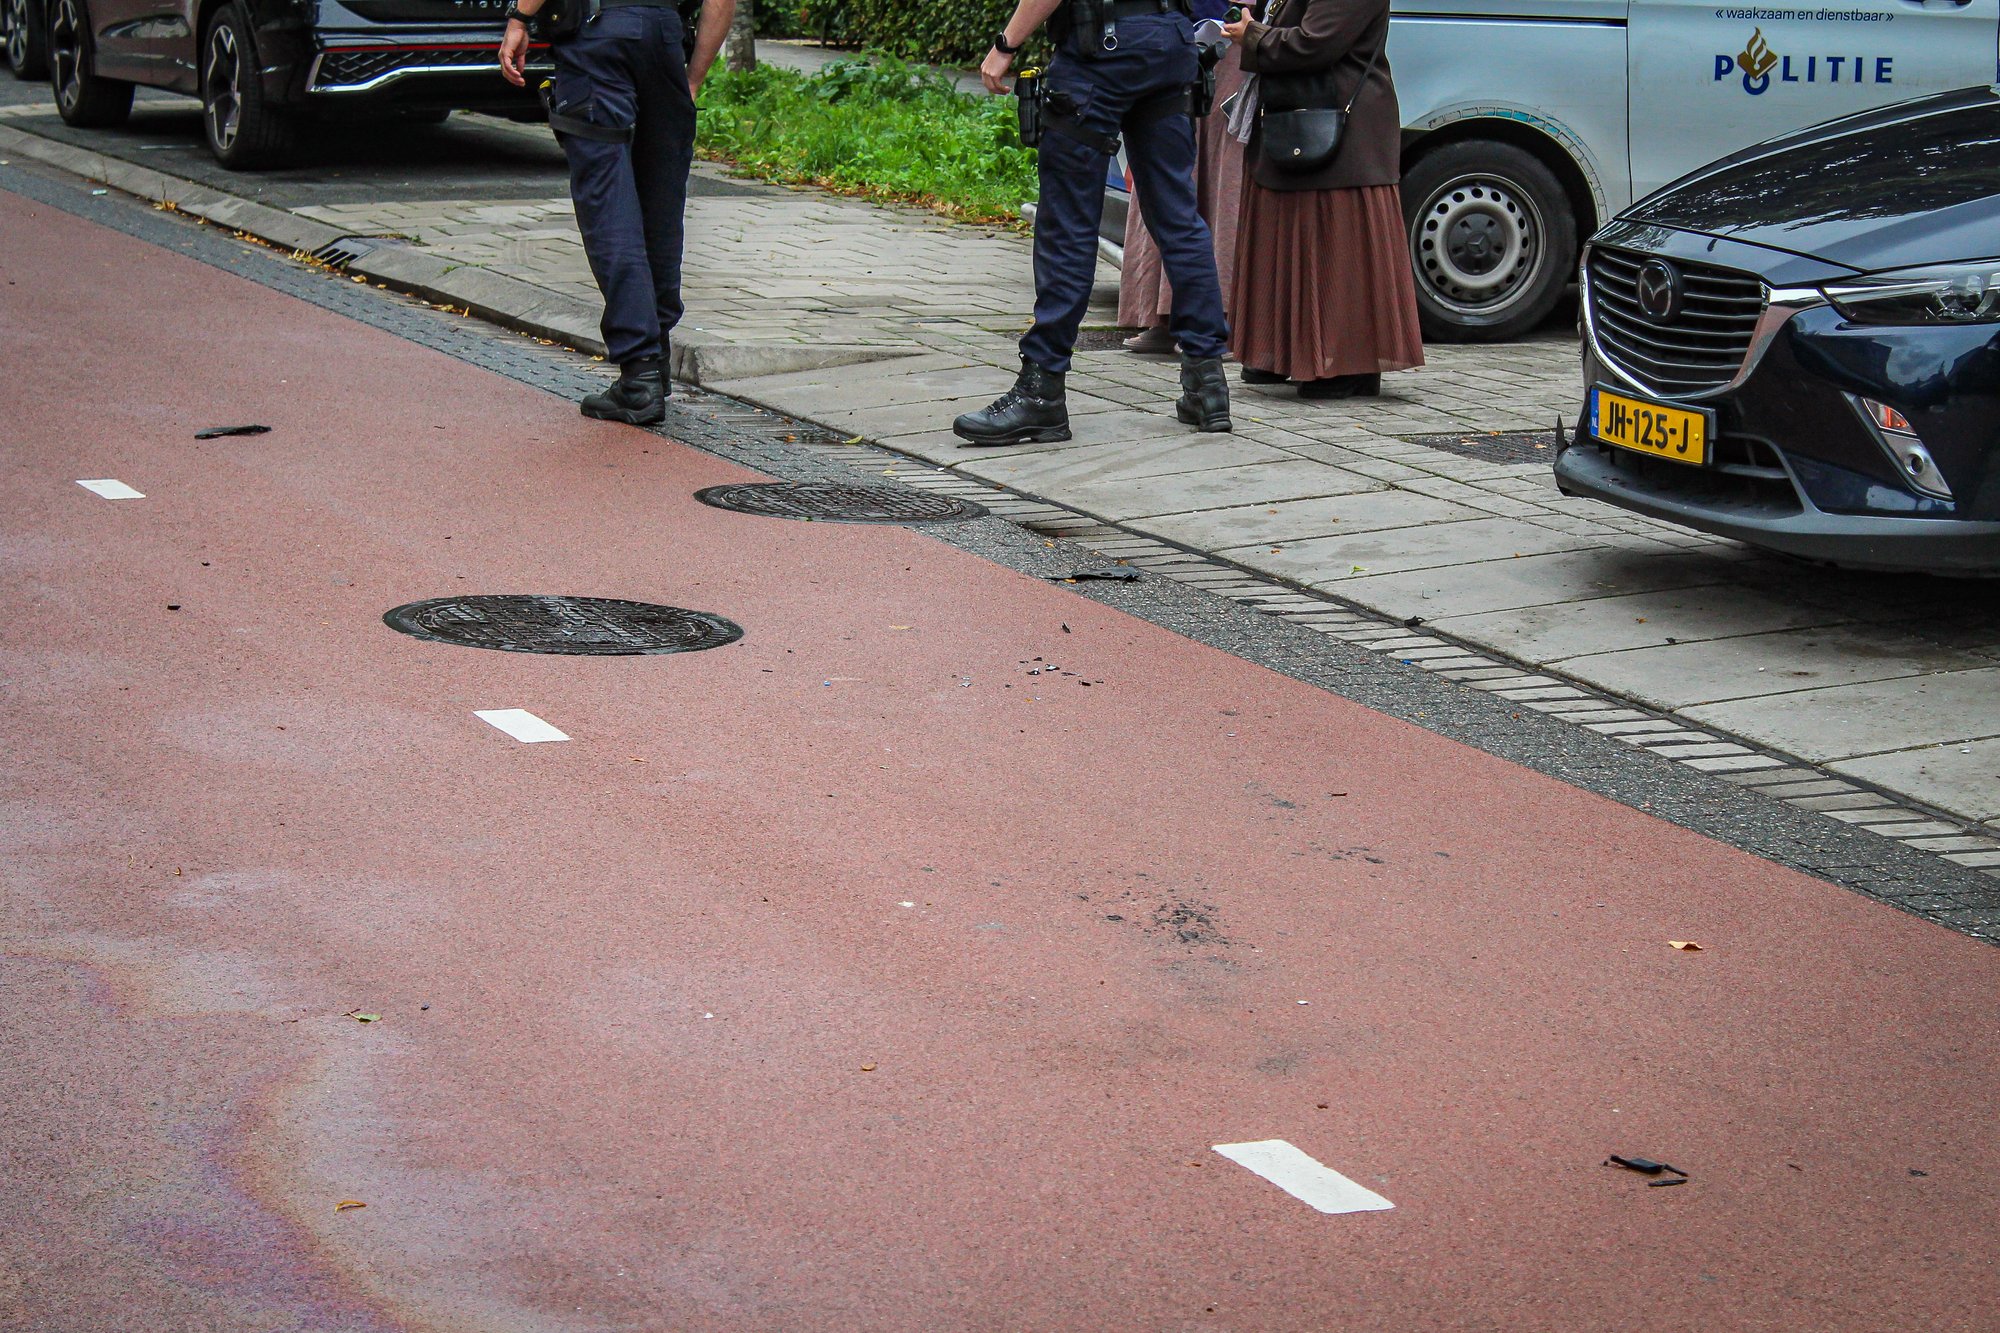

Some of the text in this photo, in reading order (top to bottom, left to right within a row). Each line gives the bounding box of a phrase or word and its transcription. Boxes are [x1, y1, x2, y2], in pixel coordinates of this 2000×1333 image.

[1797, 10, 1813, 20] en
[1714, 54, 1893, 95] POLITIE
[1591, 416, 1598, 428] NL
[1605, 401, 1689, 453] JH-125-J
